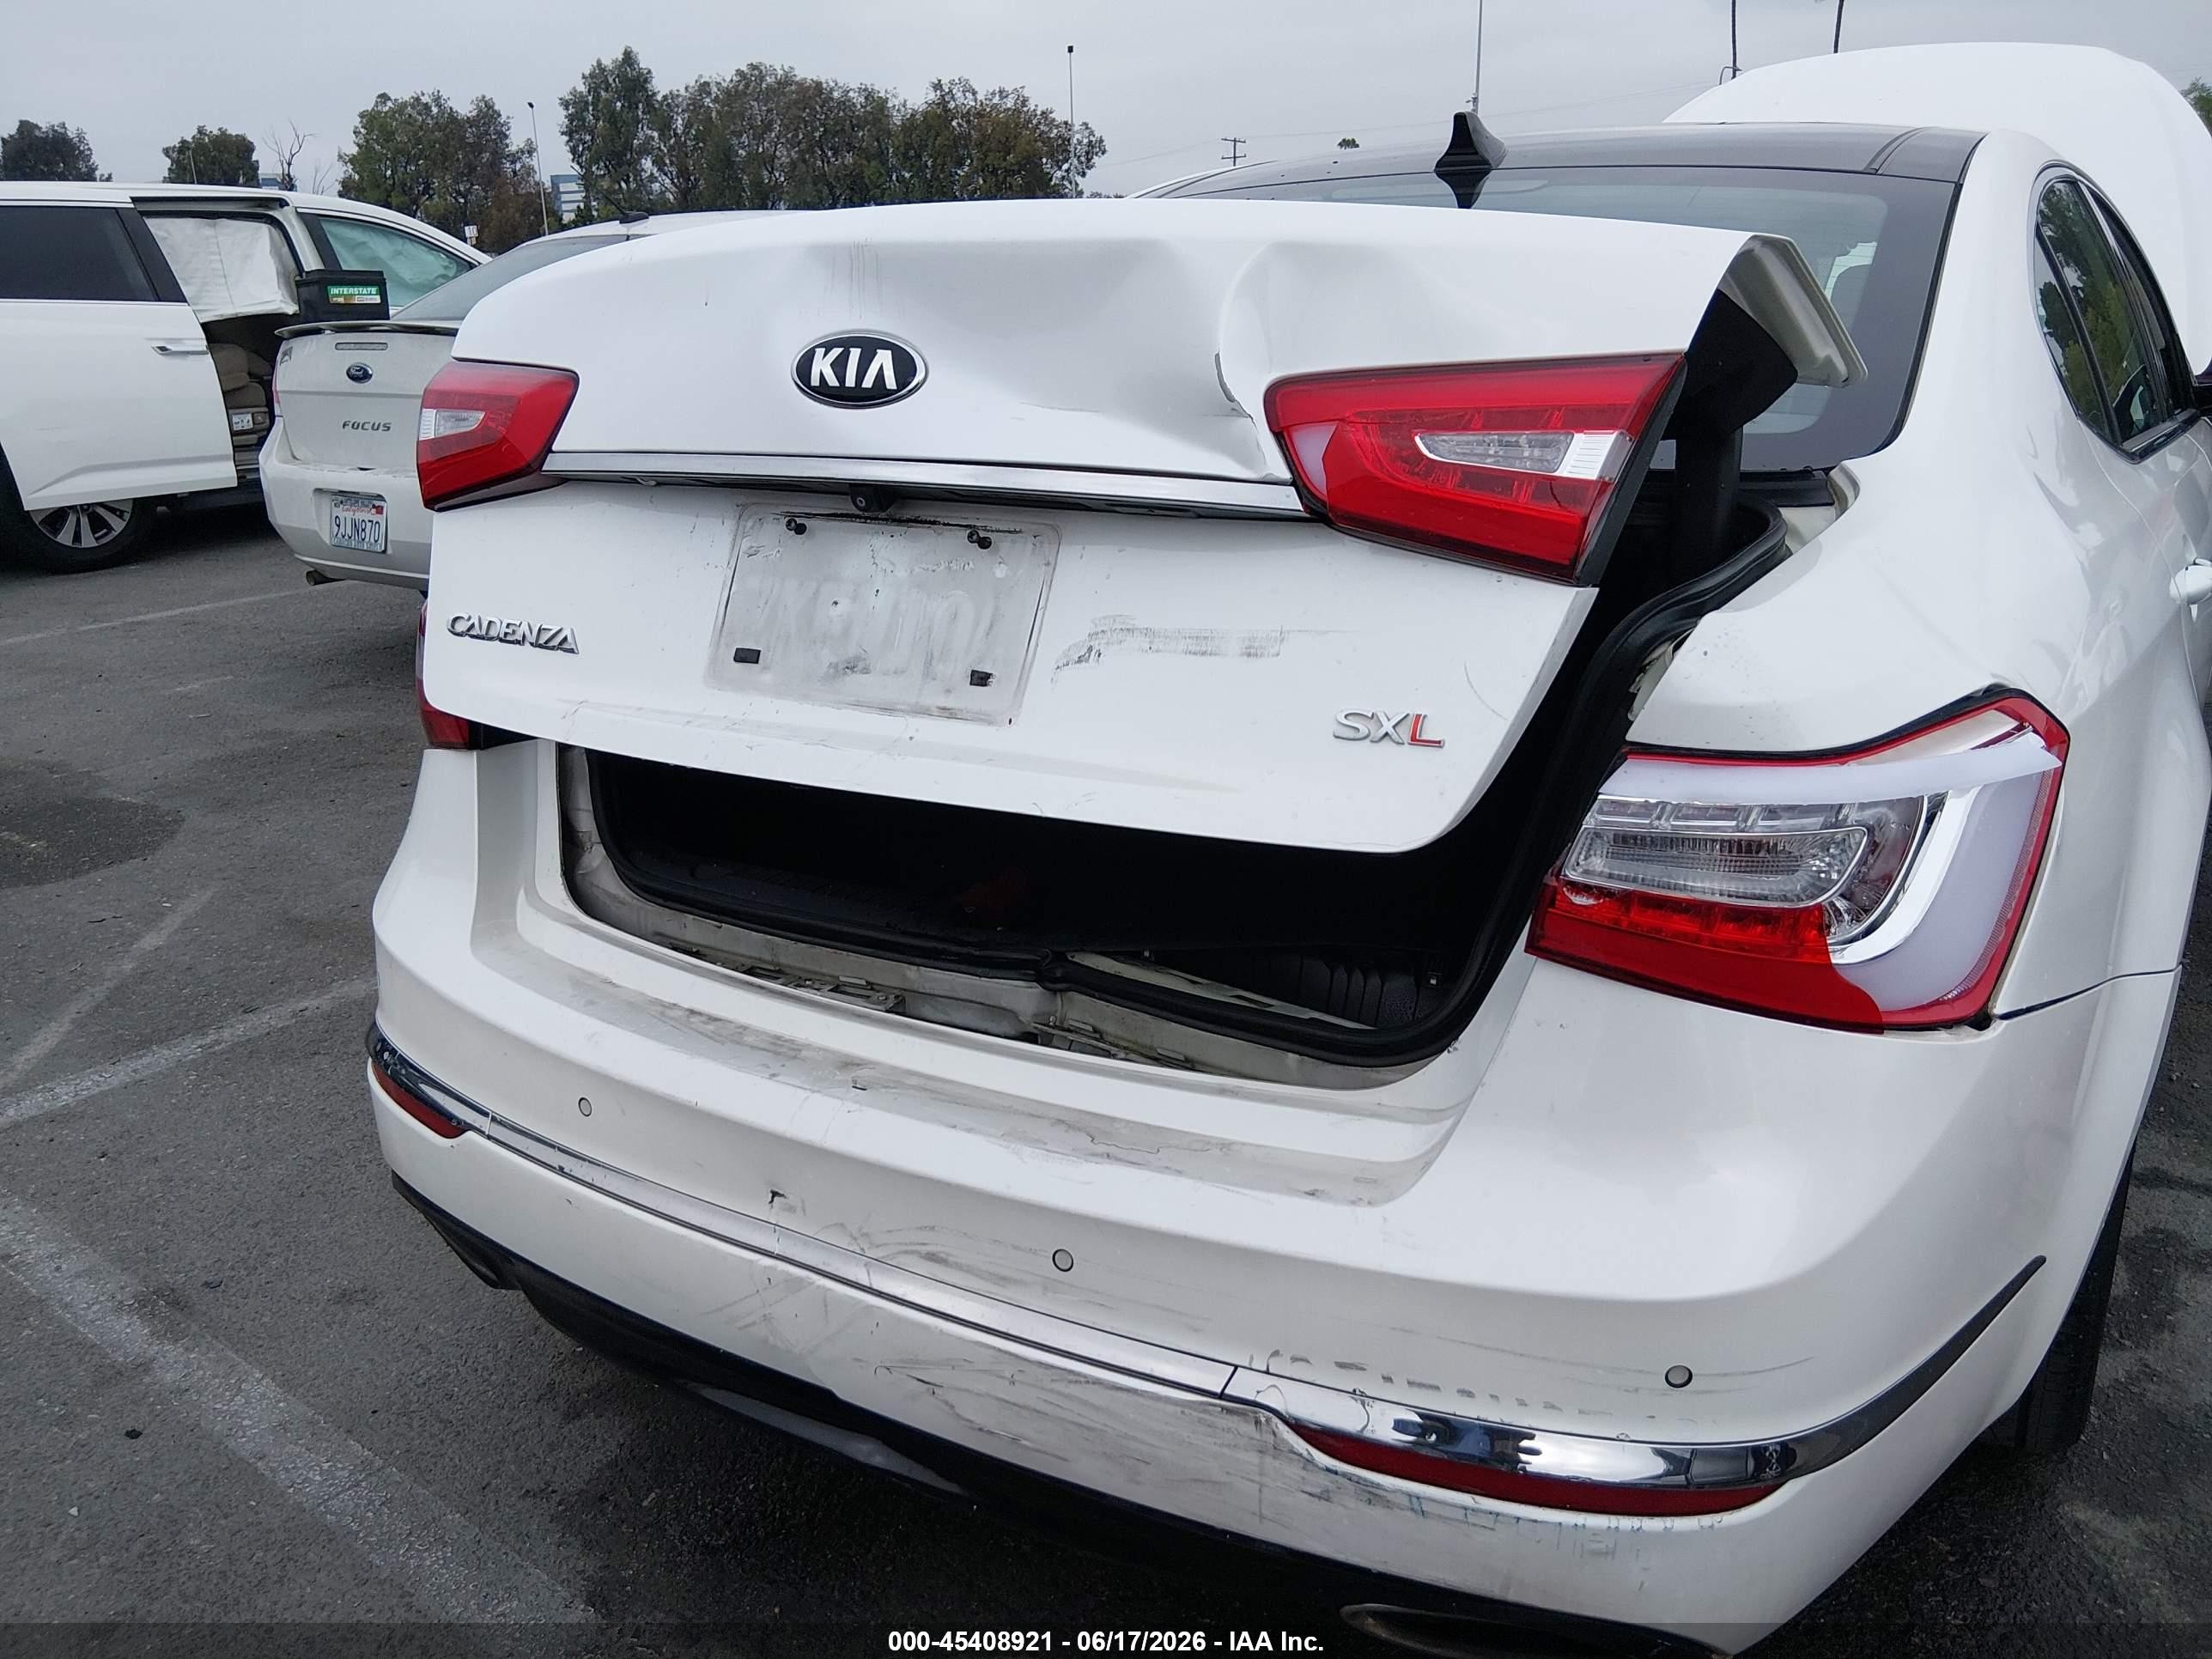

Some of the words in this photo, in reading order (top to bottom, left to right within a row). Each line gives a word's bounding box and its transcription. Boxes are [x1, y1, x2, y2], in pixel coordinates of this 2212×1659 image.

[811, 347, 898, 390] KIA
[342, 420, 392, 432] FOCUS
[334, 515, 381, 544] 9JJN870
[447, 612, 580, 654] CADENZA
[1333, 708, 1444, 748] SXL
